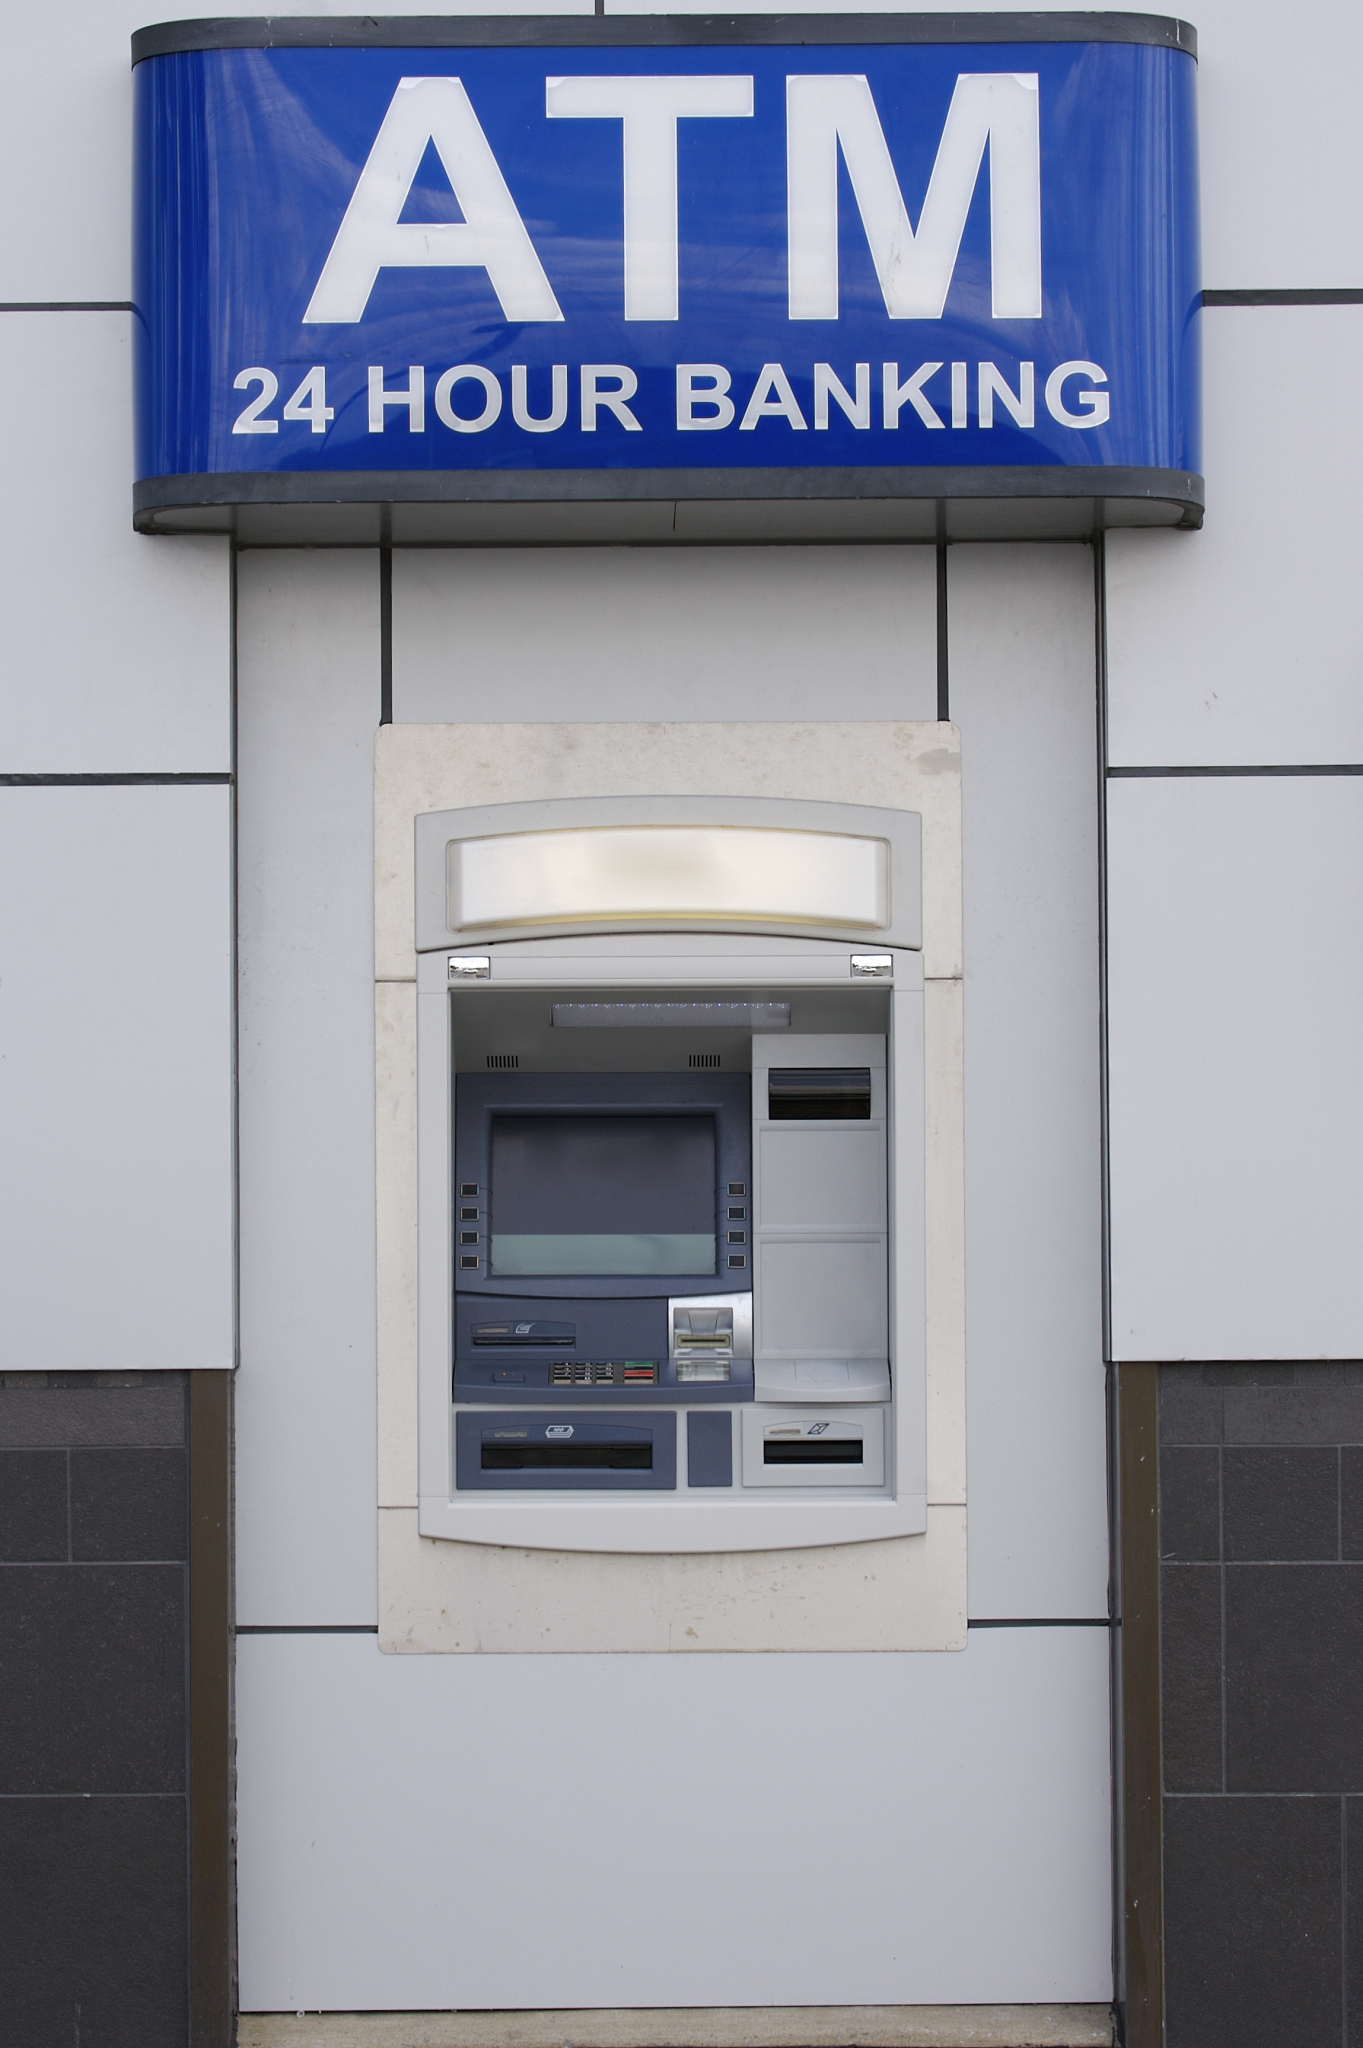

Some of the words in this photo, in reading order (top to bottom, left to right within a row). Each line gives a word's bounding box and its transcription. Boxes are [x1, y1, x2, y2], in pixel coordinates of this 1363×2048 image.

[301, 72, 1044, 325] ATM
[231, 366, 335, 435] 24
[366, 363, 643, 434] HOUR
[675, 360, 1110, 432] BANKING
